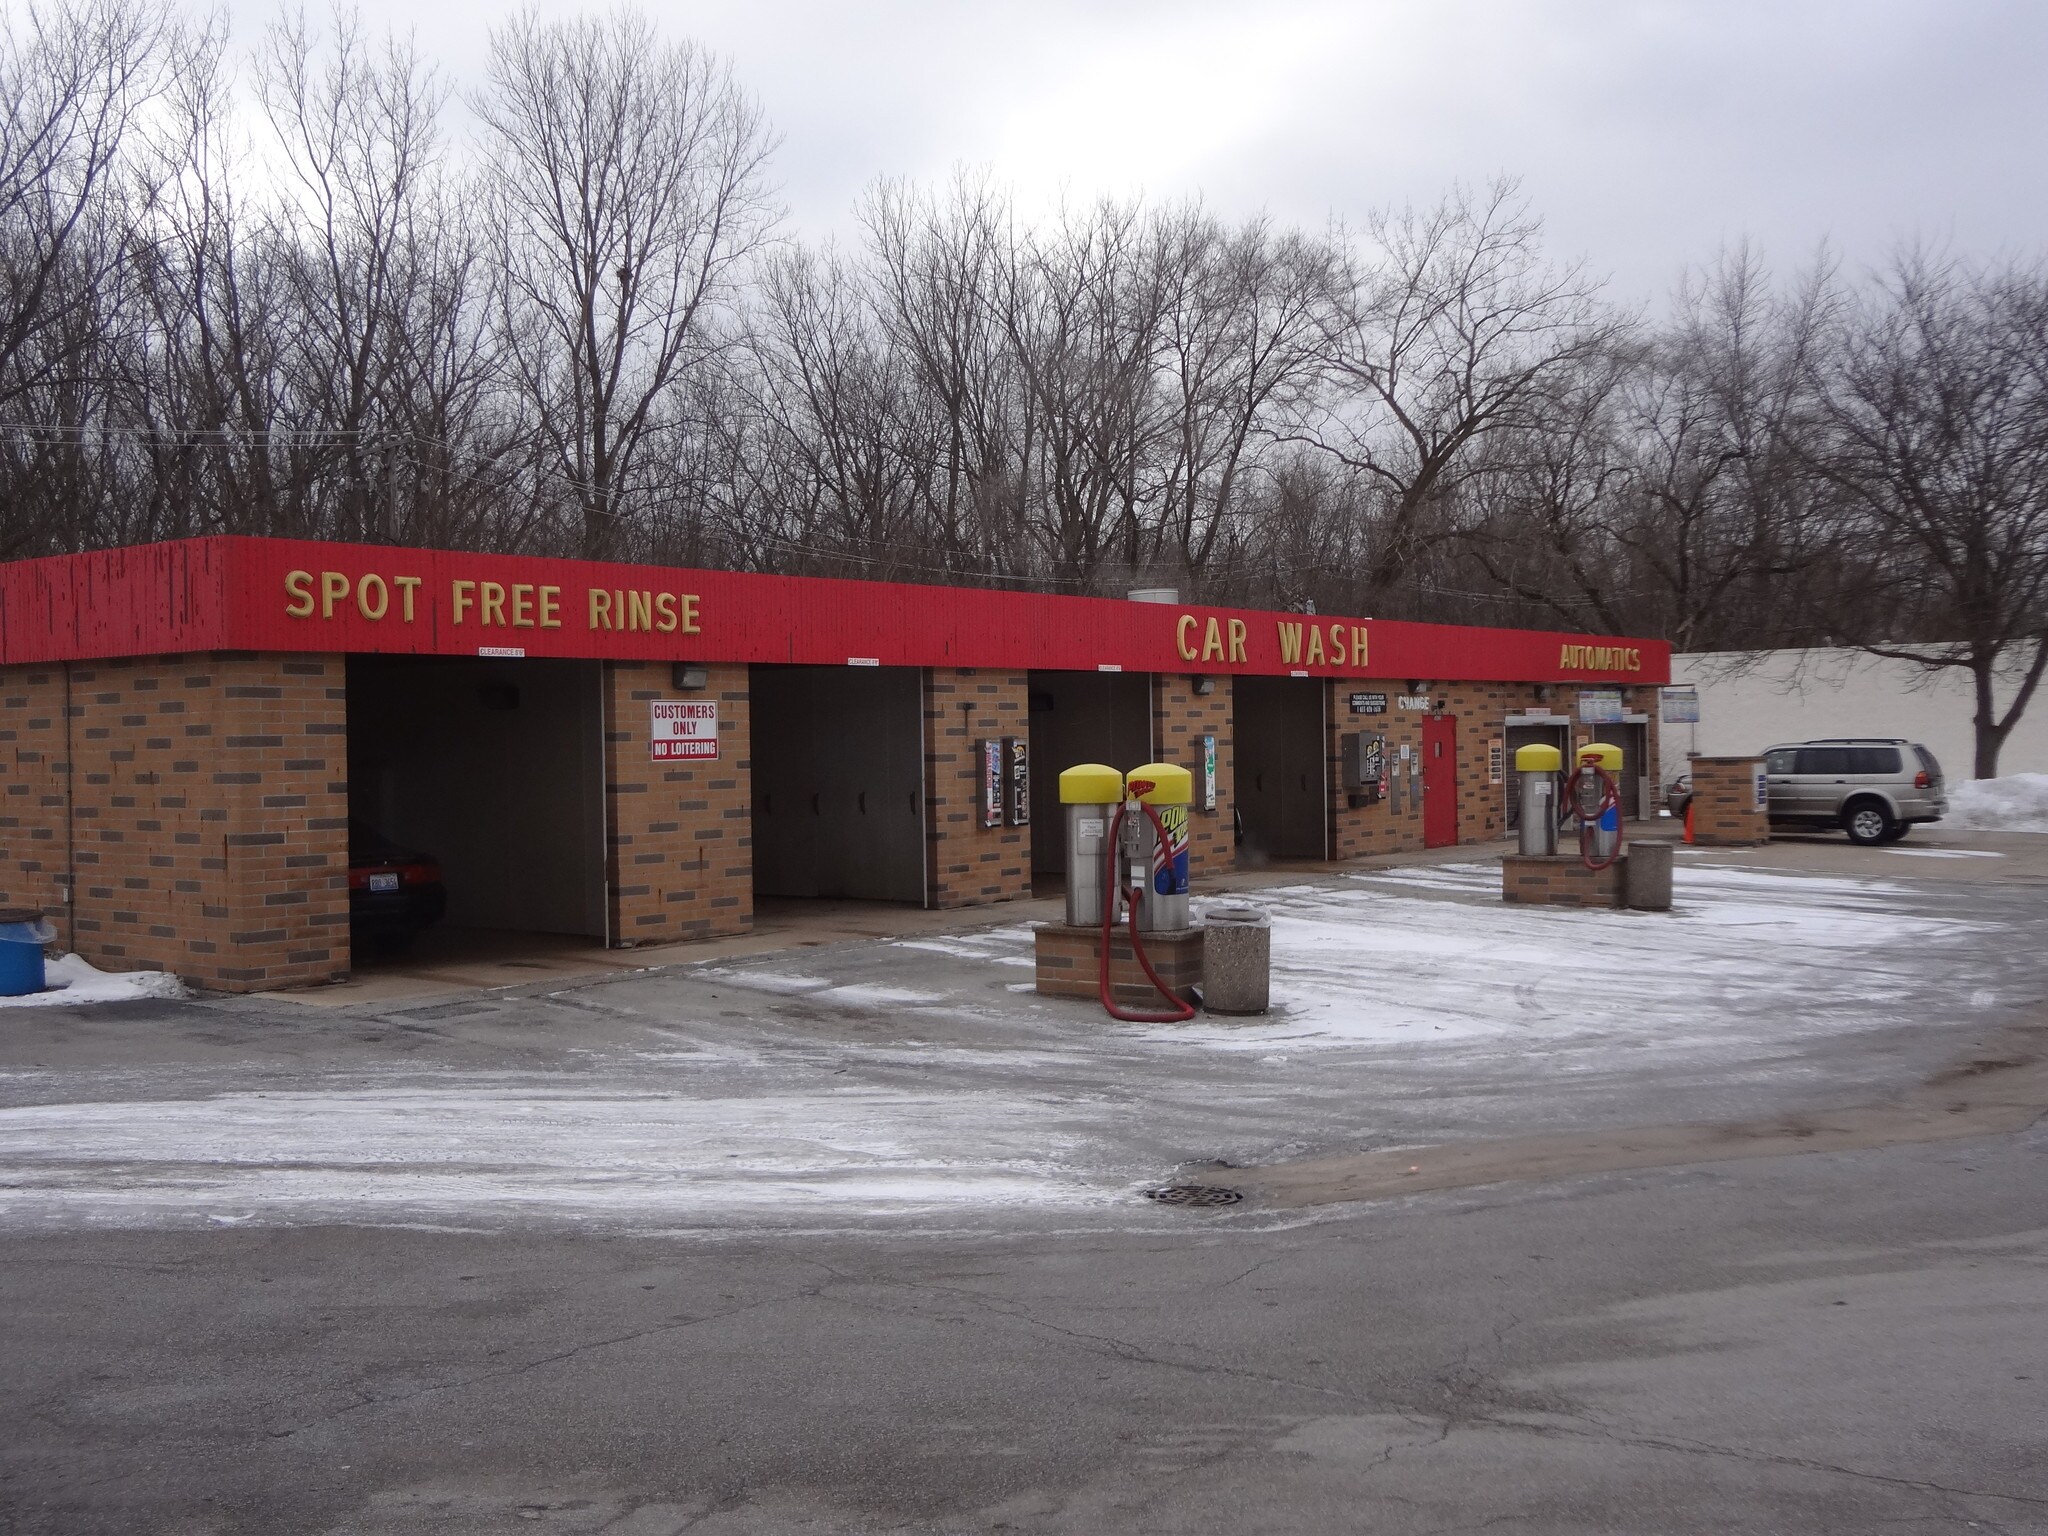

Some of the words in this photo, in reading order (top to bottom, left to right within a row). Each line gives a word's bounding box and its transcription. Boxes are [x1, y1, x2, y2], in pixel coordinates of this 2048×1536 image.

[285, 570, 421, 623] SPOT
[452, 580, 561, 628] FREE
[589, 588, 701, 635] RINSE
[1177, 614, 1247, 663] CAR
[1277, 621, 1369, 667] WASH
[480, 648, 515, 656] CLEARANCE
[1560, 644, 1640, 672] AUTOMATICS
[1398, 696, 1430, 710] CHANGE
[654, 705, 715, 719] CUSTOMERS
[673, 721, 697, 735] ONLY
[655, 742, 668, 756] NO
[671, 741, 716, 755] LOITERING
